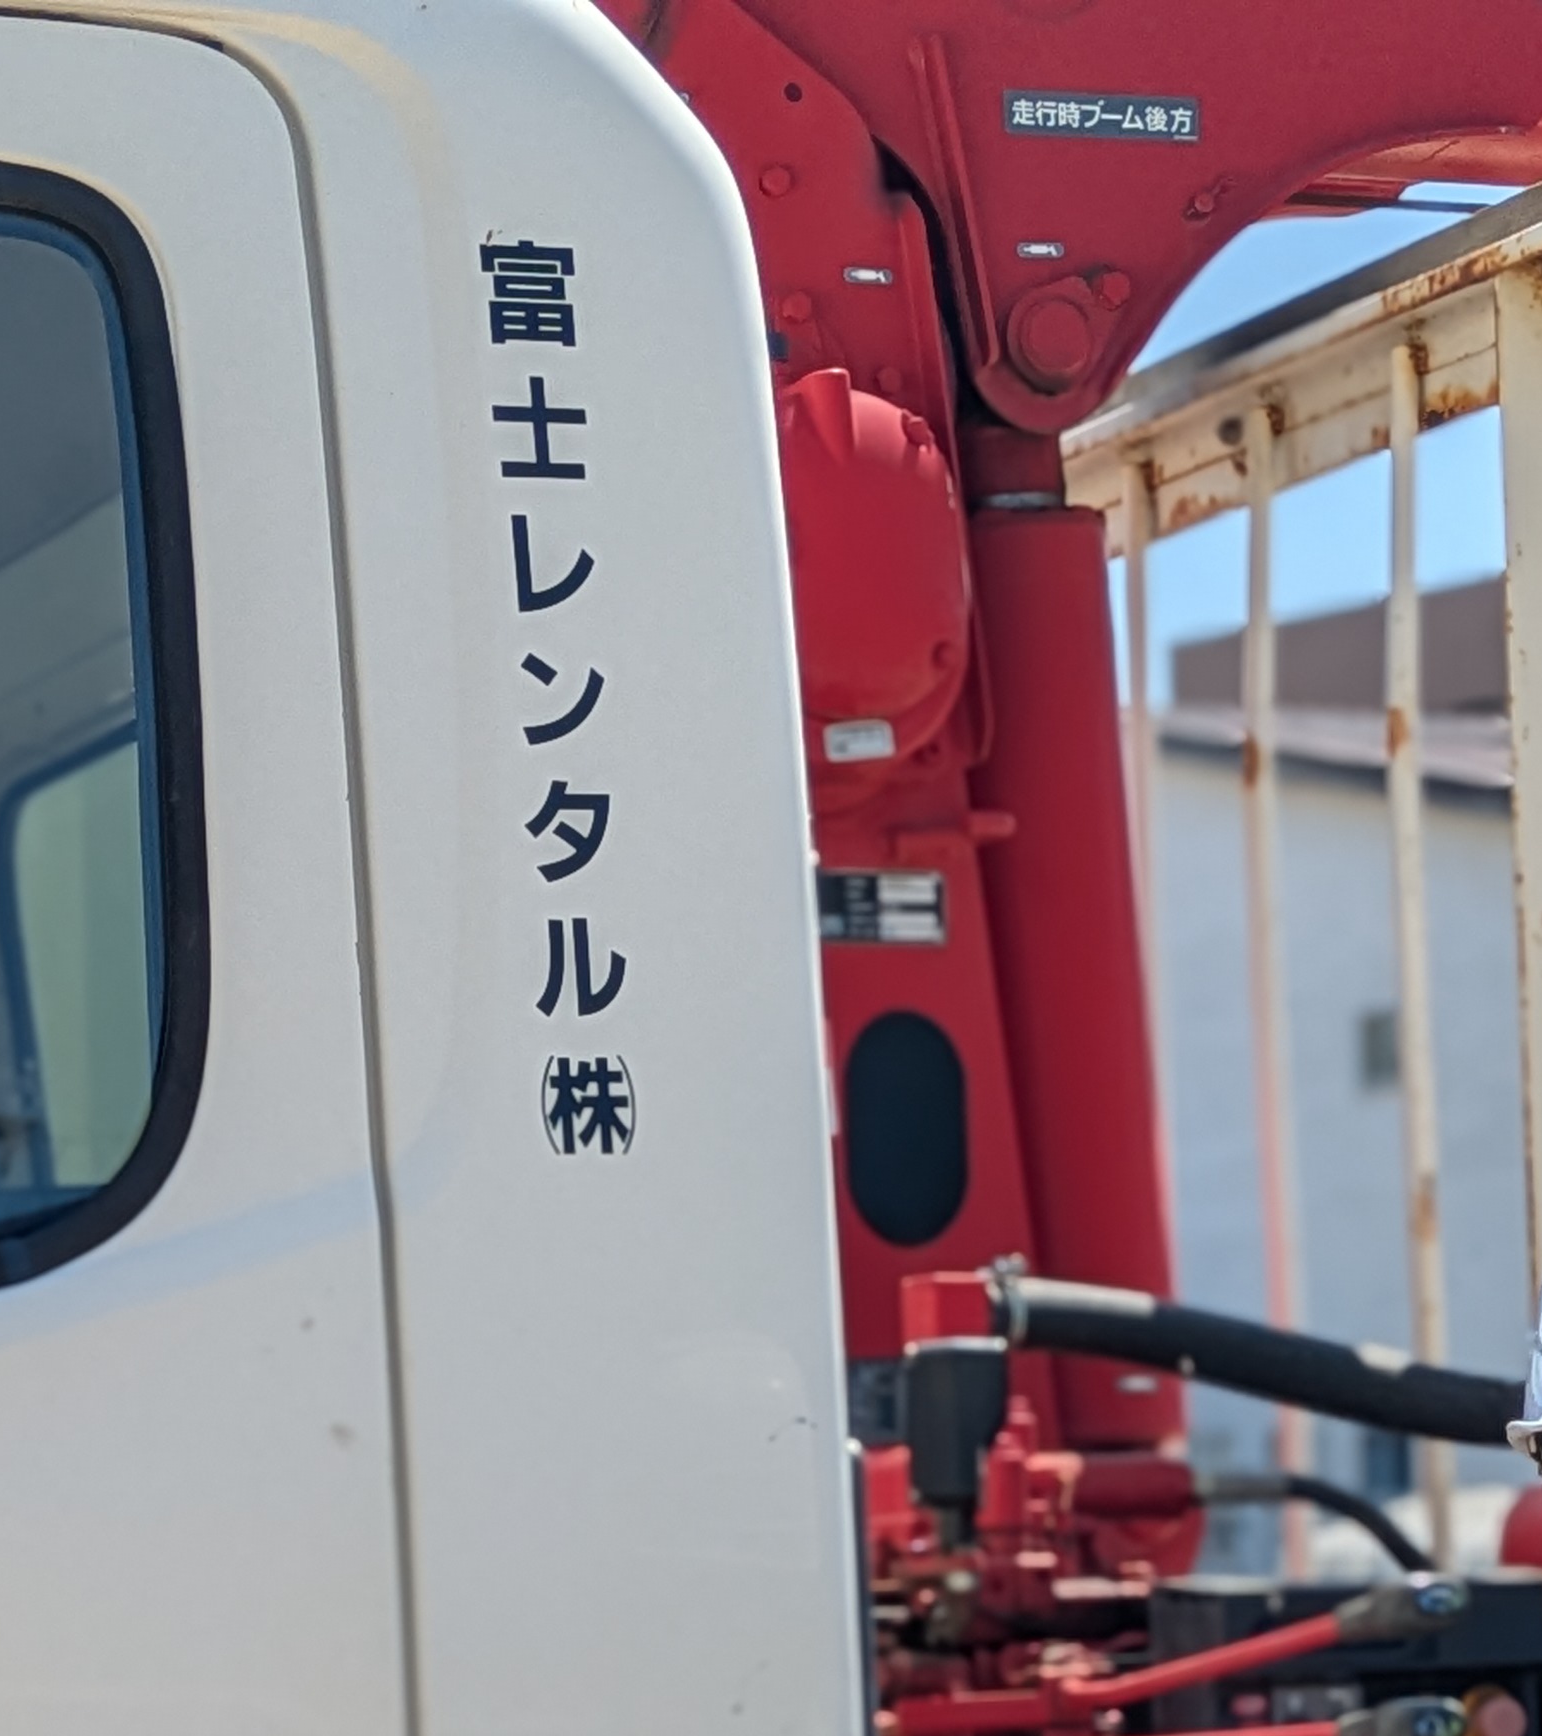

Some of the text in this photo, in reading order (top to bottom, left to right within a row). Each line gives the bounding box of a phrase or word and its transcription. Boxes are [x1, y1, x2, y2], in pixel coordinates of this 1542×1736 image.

[1012, 98, 1193, 133] 走行時ブーム後方
